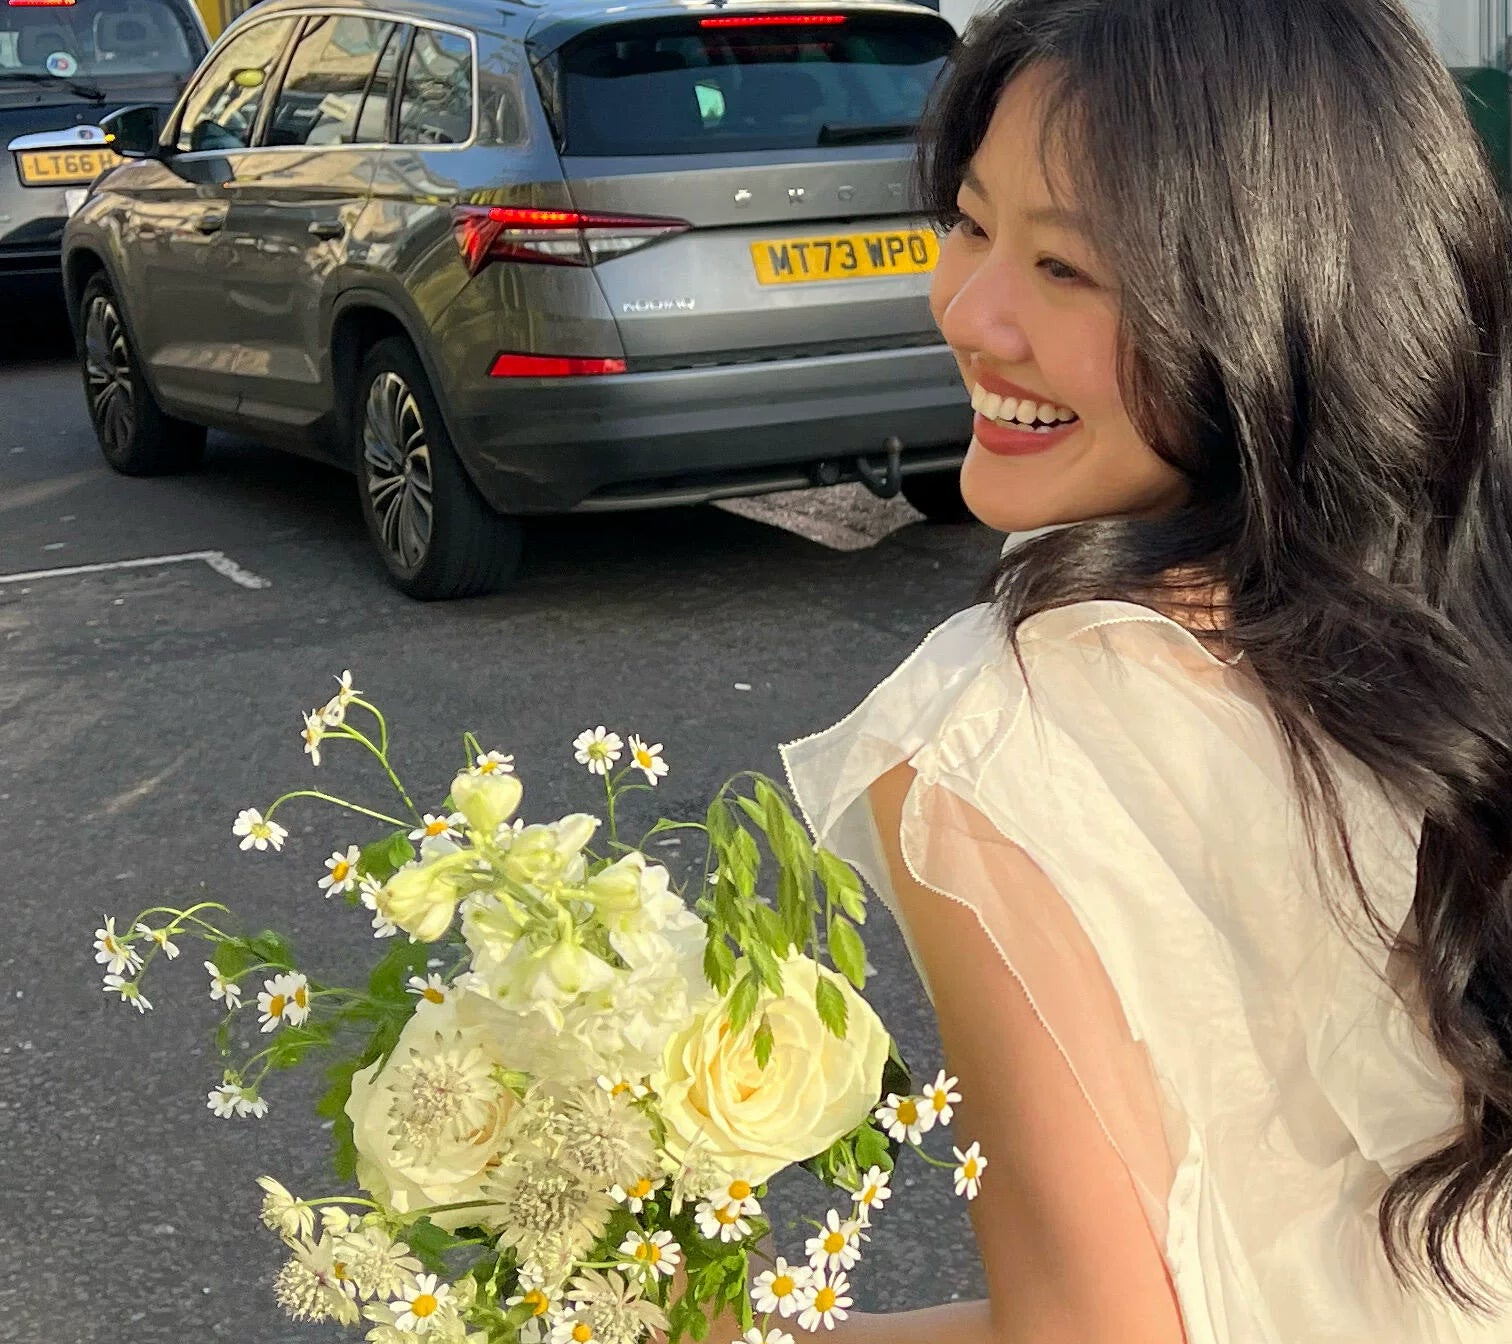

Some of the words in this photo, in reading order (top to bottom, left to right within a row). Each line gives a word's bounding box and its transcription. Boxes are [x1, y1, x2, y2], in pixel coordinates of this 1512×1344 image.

[33, 154, 94, 176] LT66
[768, 241, 857, 277] MT73
[863, 235, 928, 268] WPO
